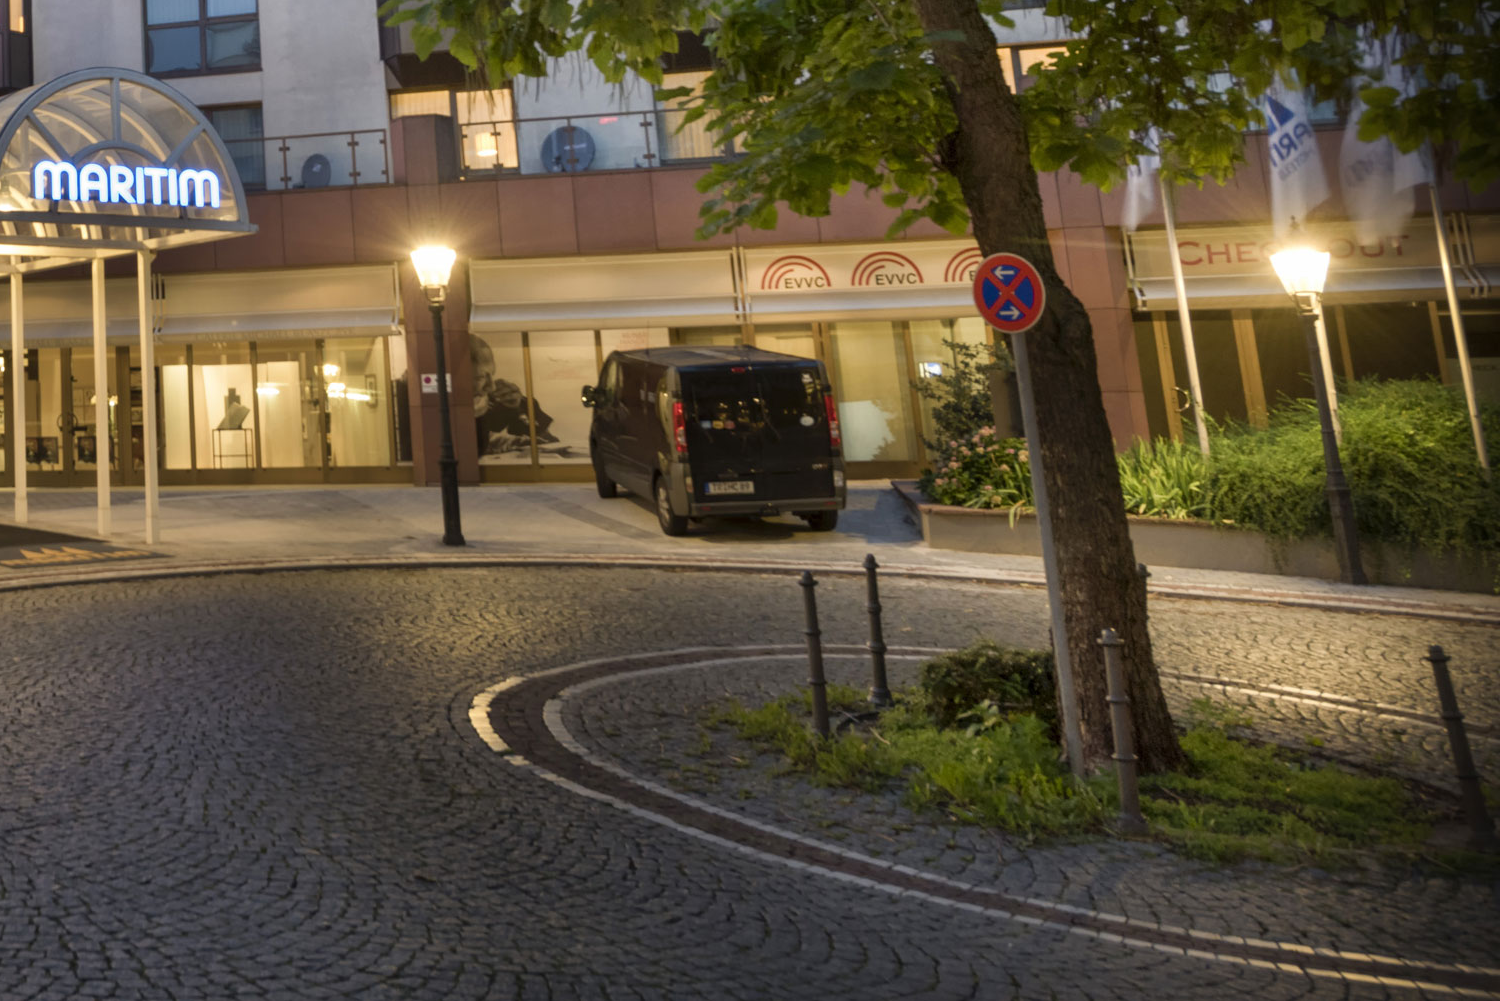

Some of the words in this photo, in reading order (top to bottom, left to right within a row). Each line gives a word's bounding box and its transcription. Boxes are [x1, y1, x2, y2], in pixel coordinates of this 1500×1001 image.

[33, 159, 221, 209] MARITIM
[1176, 240, 1281, 267] CHEC
[784, 275, 826, 289] EVVC
[875, 272, 918, 285] EVVC
